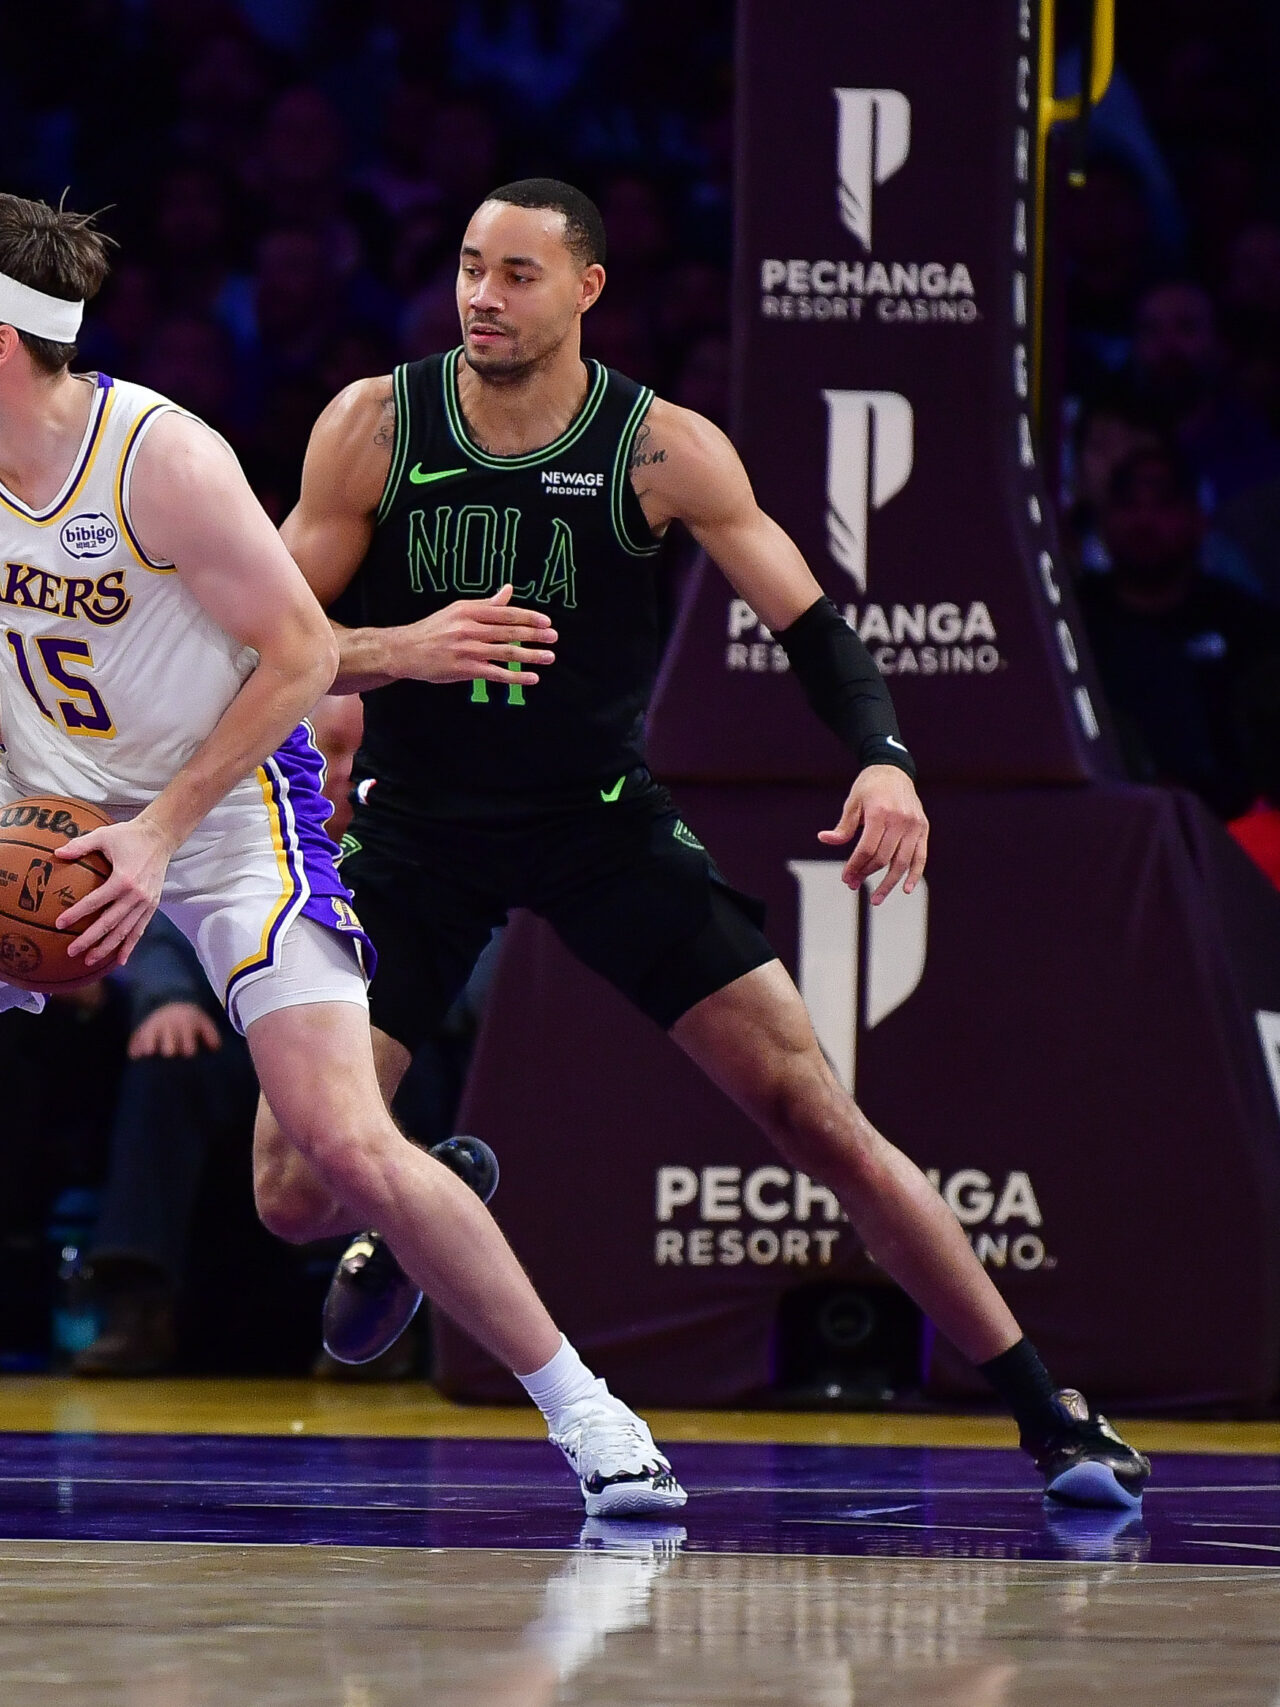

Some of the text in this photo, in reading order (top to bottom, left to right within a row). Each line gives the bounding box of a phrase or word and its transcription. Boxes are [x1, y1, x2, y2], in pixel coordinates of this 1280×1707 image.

[761, 259, 975, 297] PECHANGA
[762, 296, 977, 323] RESORT CASINO
[541, 471, 604, 487] NEWAGE
[545, 486, 597, 497] PRODUCTS
[66, 525, 114, 544] bibigo
[408, 505, 578, 609] NOLA
[729, 599, 997, 643] PANGA
[4, 628, 118, 740] 15
[655, 1165, 1043, 1227] PECHGA
[655, 1228, 840, 1266] RESORT
